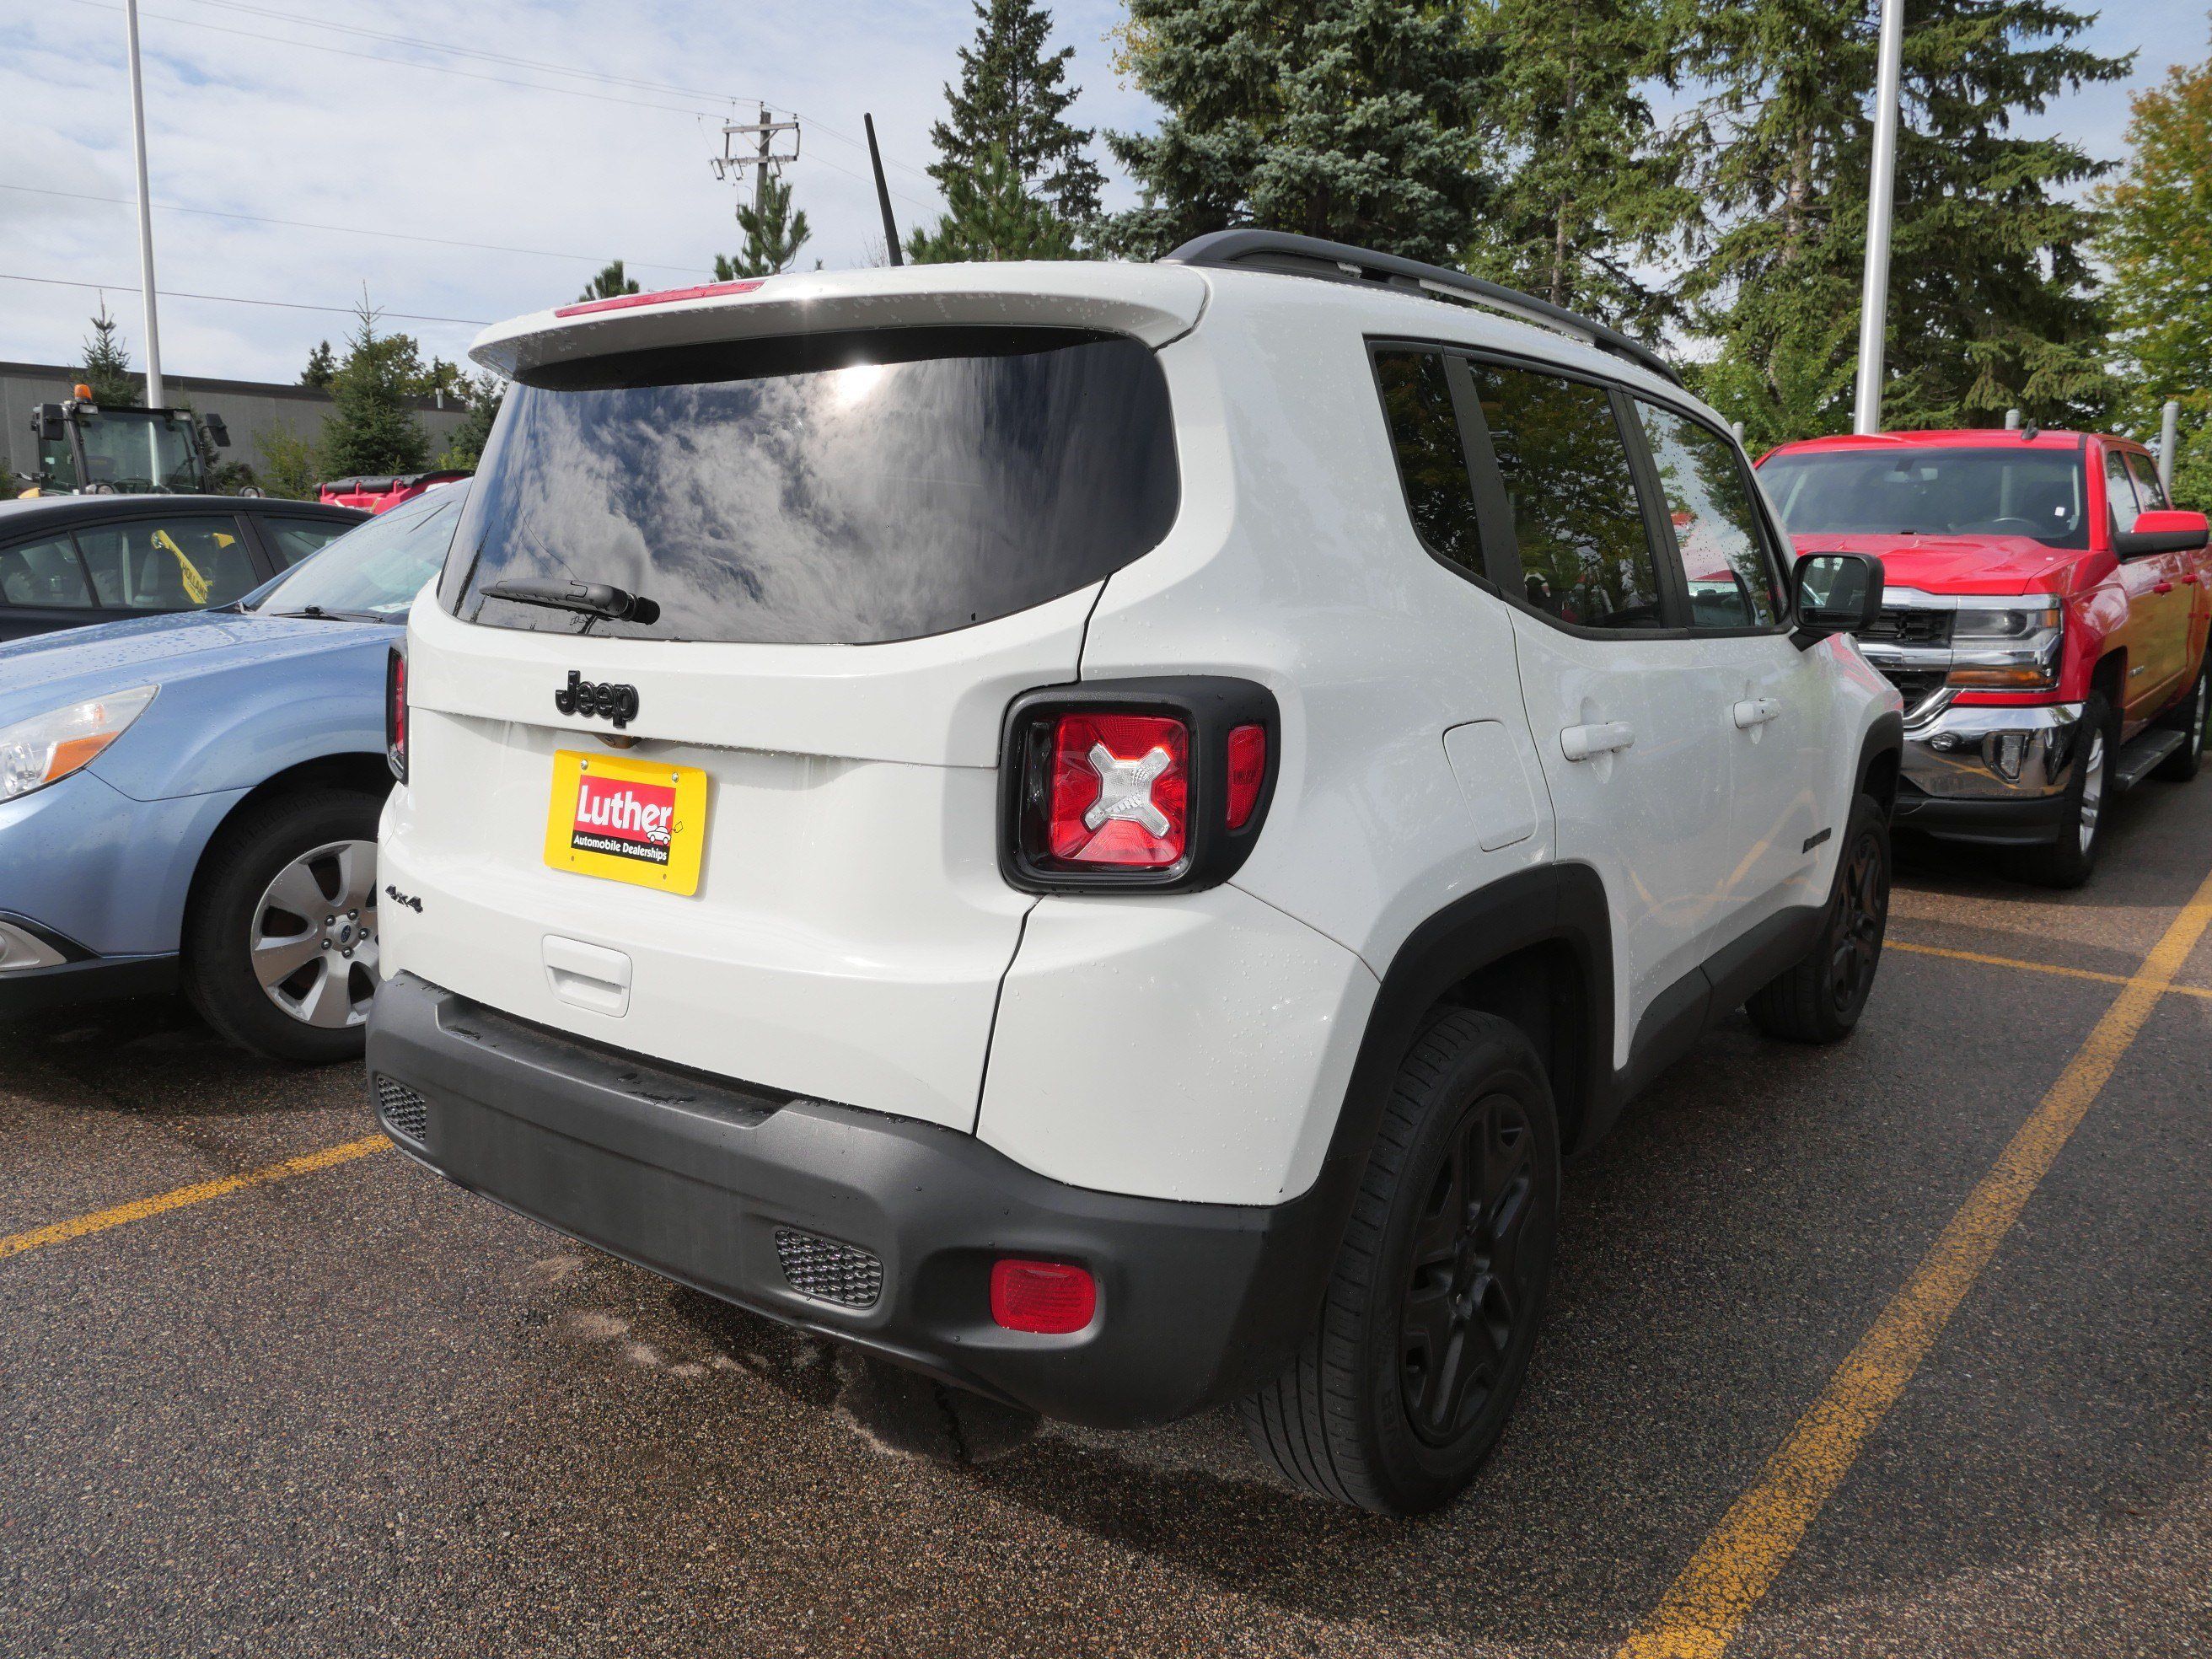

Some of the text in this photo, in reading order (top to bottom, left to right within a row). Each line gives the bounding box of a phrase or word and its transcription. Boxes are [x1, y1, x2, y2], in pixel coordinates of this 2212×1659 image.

[556, 670, 639, 728] Jeep
[577, 785, 673, 834] Luther
[573, 835, 668, 861] Automobile Dealerships
